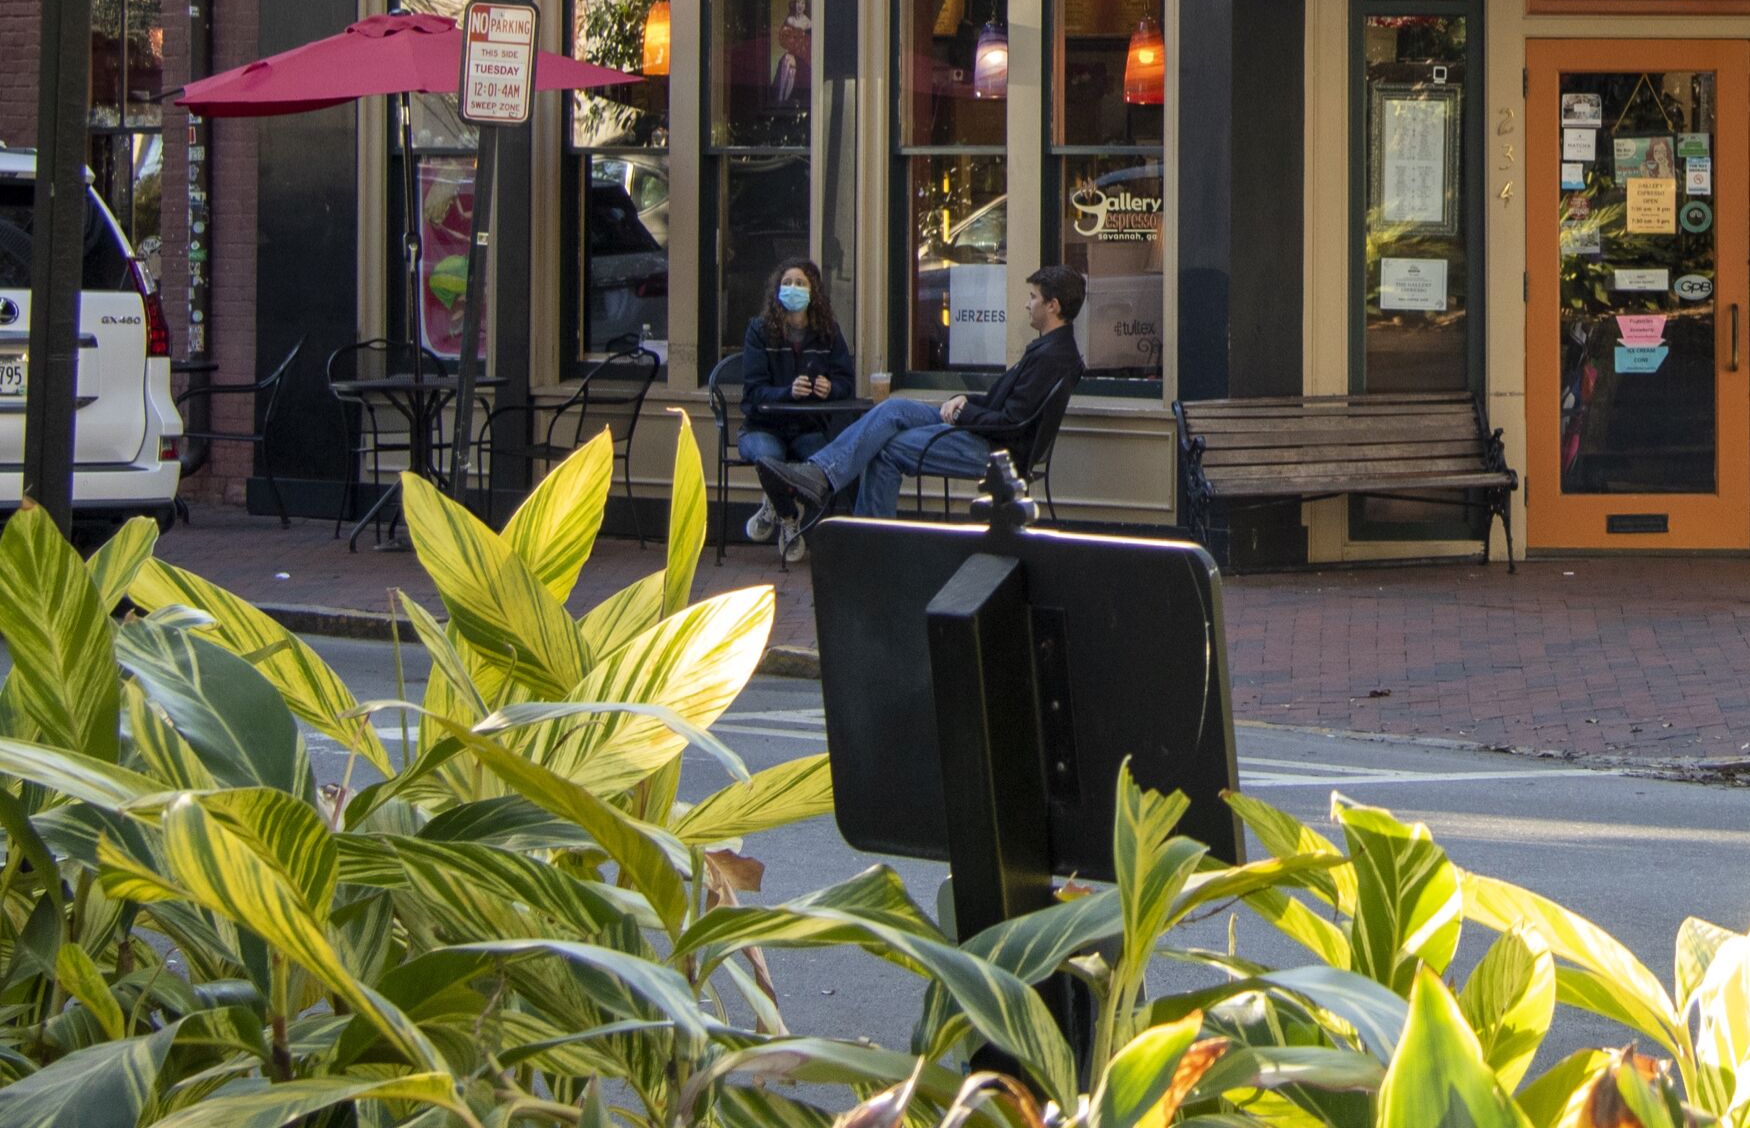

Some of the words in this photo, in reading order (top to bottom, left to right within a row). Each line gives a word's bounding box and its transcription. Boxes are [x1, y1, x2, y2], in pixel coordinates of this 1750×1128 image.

[471, 12, 489, 34] NO
[491, 19, 530, 36] PARKING
[481, 48, 498, 58] THIS
[502, 50, 518, 59] SIDE
[475, 64, 520, 76] TUESDAY
[471, 101, 496, 110] SWEEP
[499, 102, 520, 112] ZONE
[1105, 213, 1157, 232] espresso
[1146, 233, 1157, 242] ga
